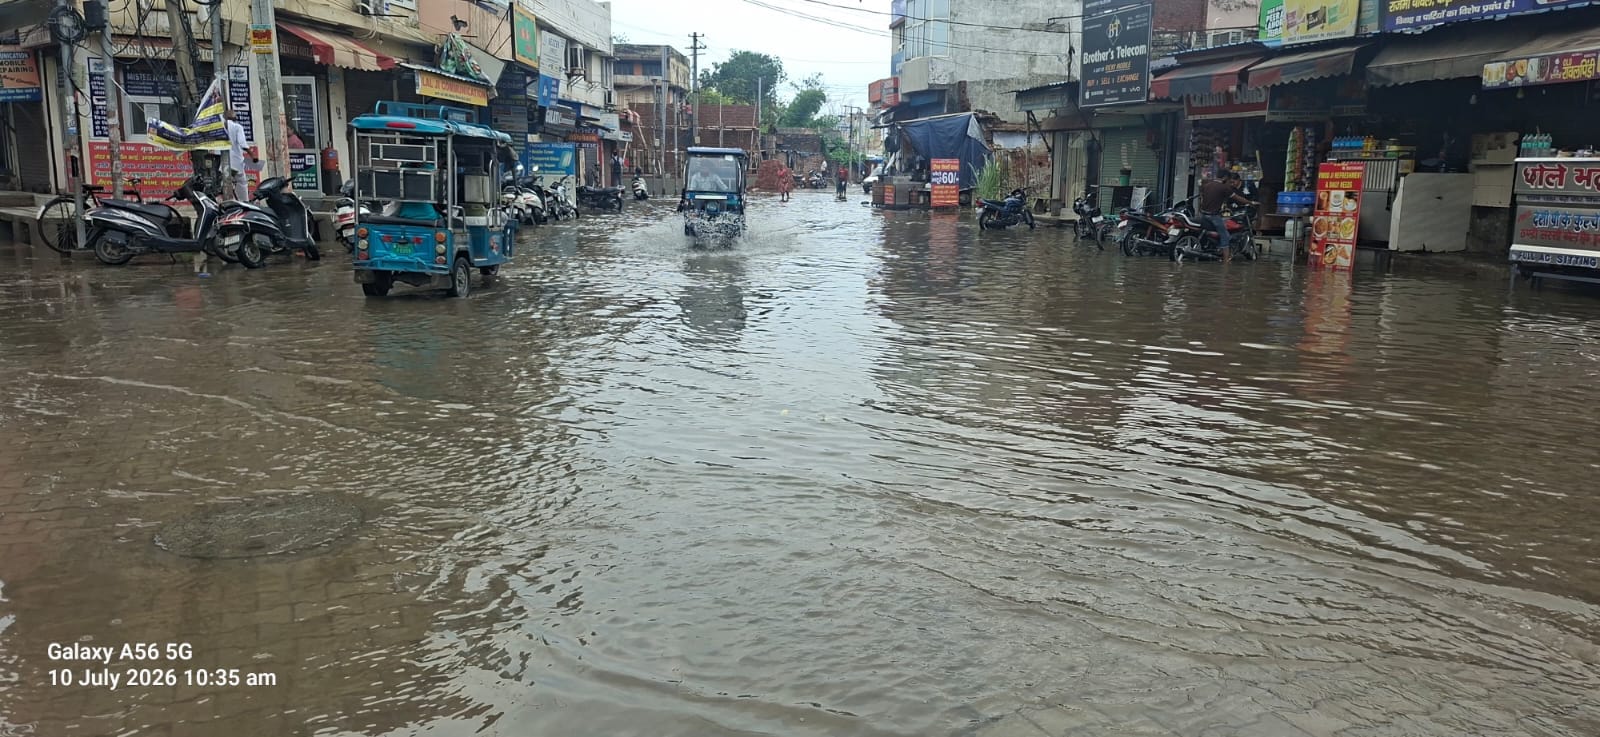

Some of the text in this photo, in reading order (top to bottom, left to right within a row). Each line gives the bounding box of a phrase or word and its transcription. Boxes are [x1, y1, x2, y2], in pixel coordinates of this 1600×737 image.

[1083, 44, 1147, 65] Brother's Telecom
[942, 171, 960, 184] 60/-
[1539, 254, 1551, 264] AC
[1557, 256, 1597, 269] SITTING
